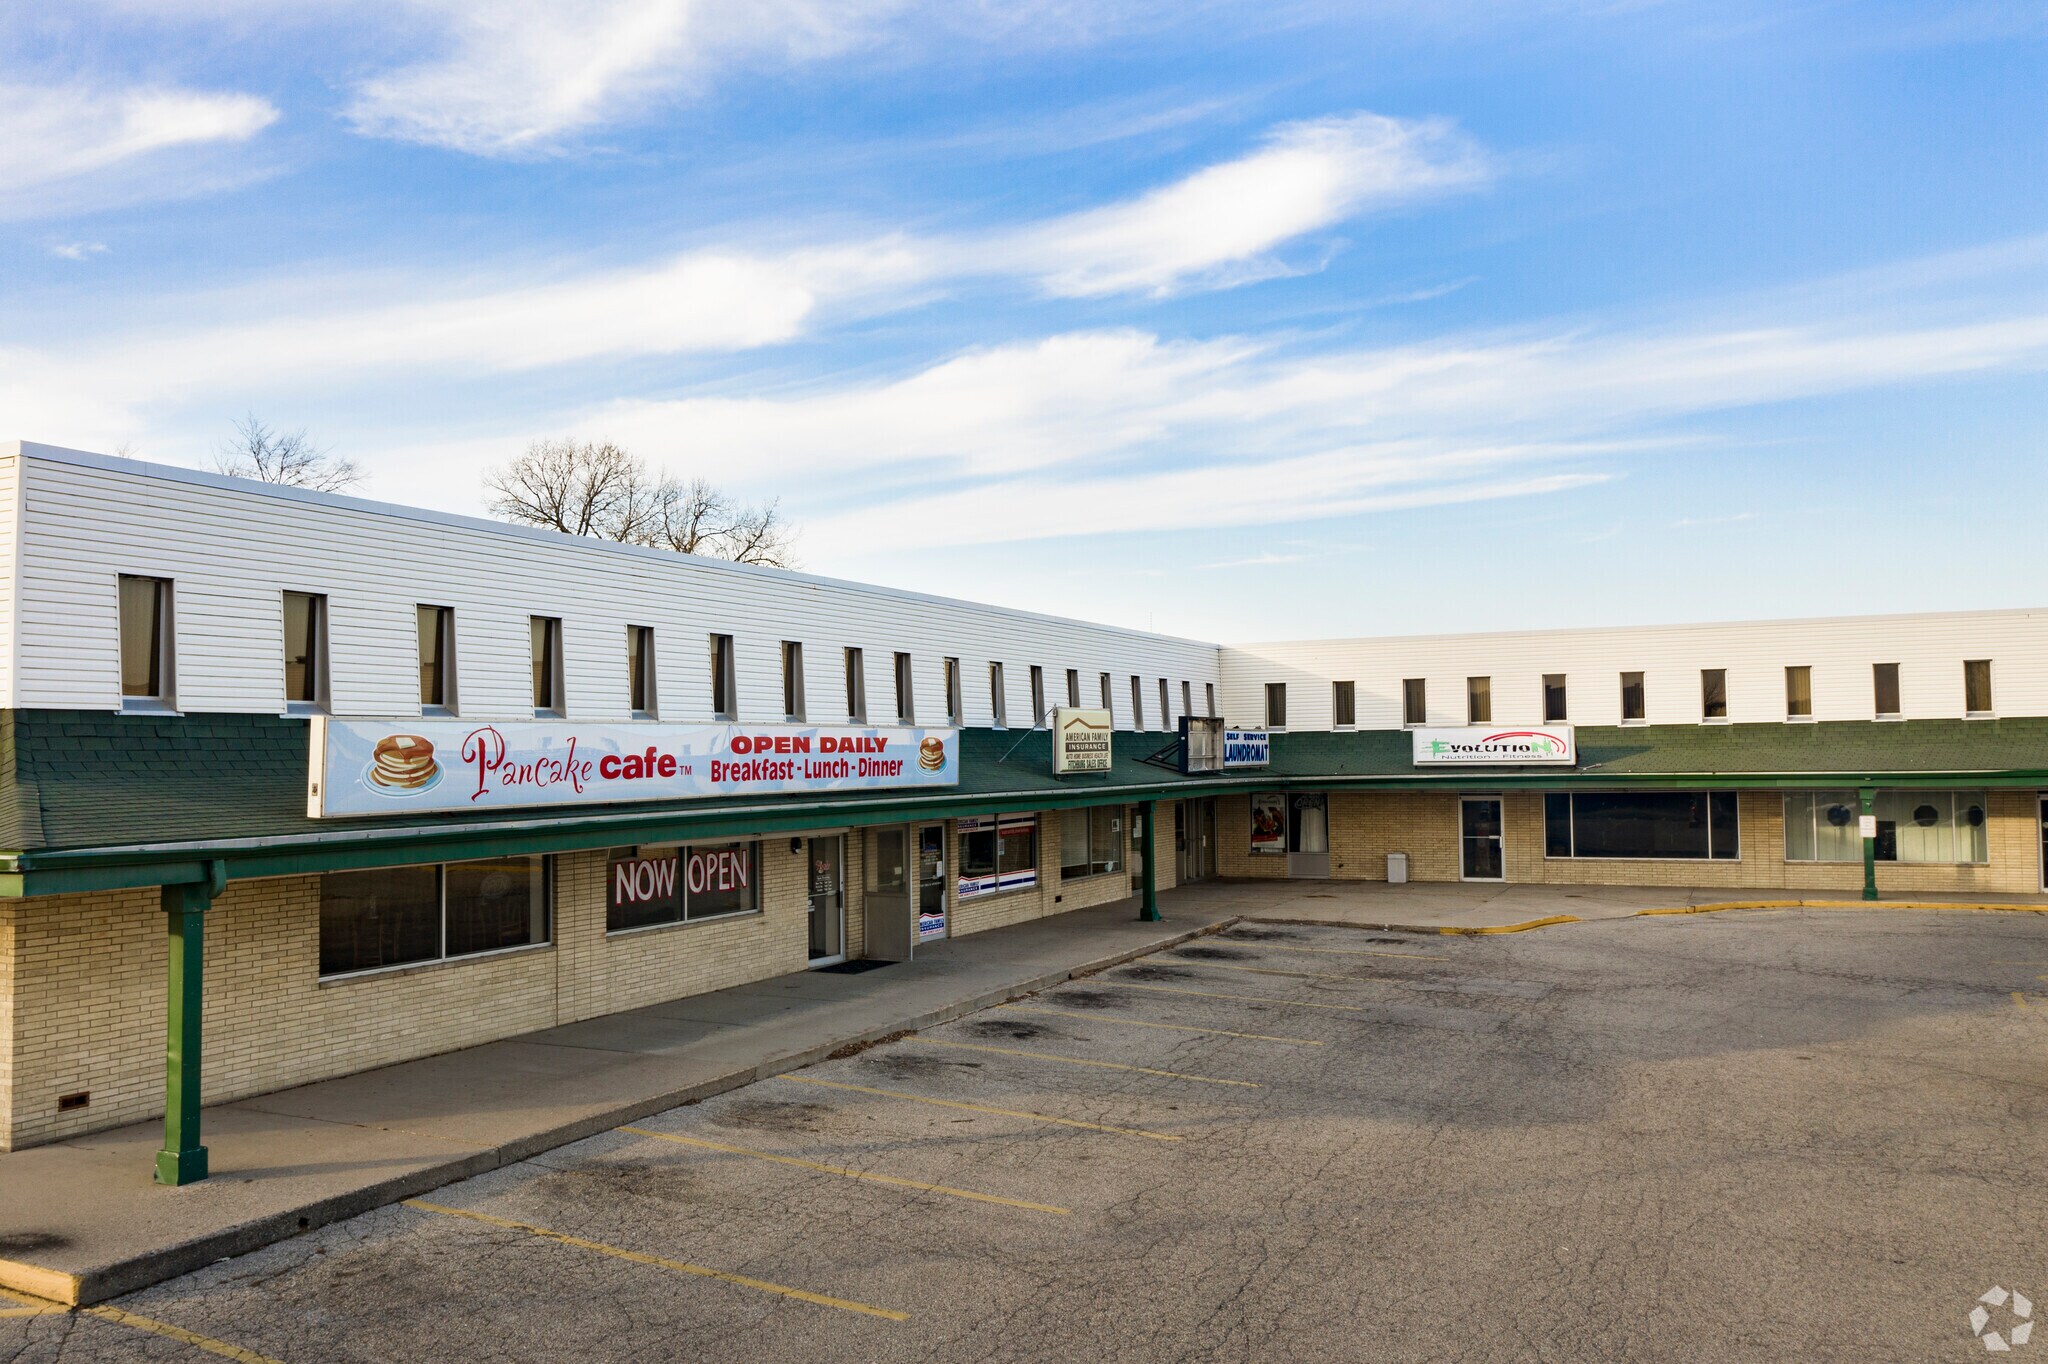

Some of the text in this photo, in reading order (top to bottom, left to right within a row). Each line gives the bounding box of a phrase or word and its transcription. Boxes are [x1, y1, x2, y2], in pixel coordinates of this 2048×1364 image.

[730, 735, 888, 755] OPEN DAILY
[1065, 732, 1109, 741] AMERICAN FAMILY
[1226, 732, 1267, 741] SELF SERVICE
[461, 724, 593, 802] Pancake
[600, 746, 677, 780] cafe
[1224, 744, 1269, 762] LAUNDROMAT
[710, 758, 794, 782] Breakfast
[804, 757, 849, 779] Lunch
[858, 757, 904, 777] Dinner
[615, 850, 748, 906] NOW OPEN
